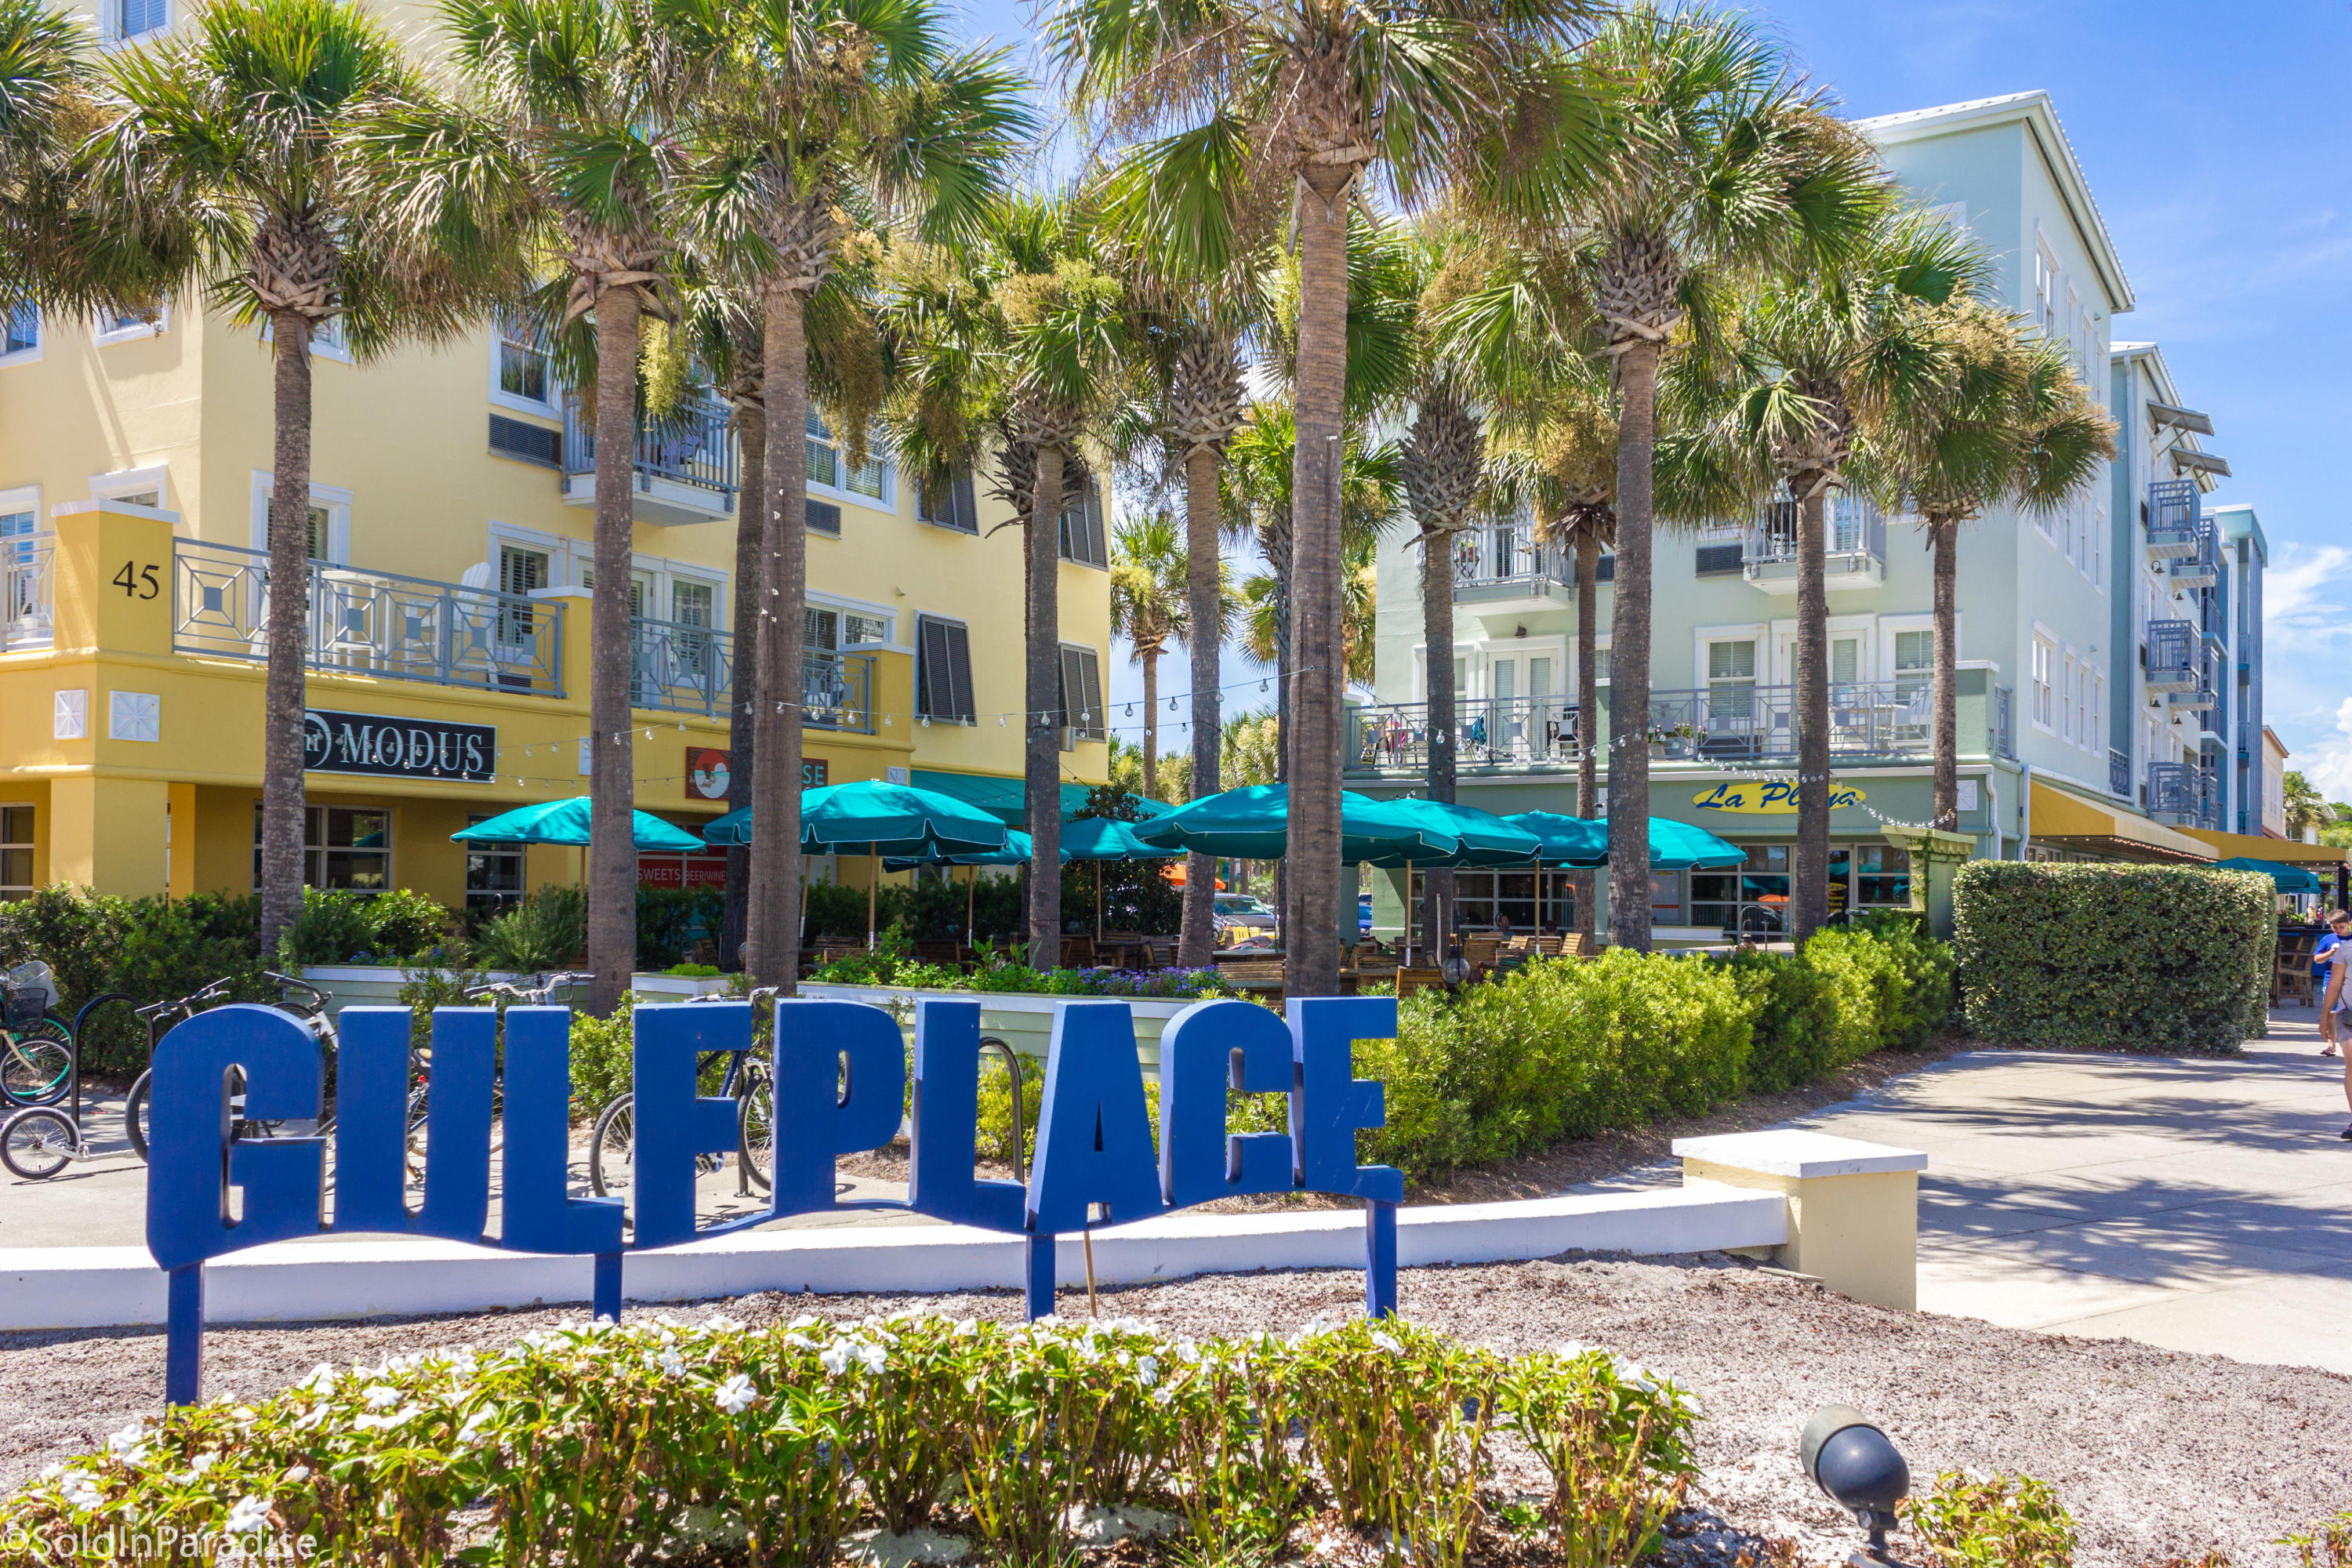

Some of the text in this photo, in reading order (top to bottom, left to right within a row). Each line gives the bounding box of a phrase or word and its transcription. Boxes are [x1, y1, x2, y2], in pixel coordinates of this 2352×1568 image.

[112, 560, 160, 600] 45
[339, 723, 484, 773] MODUS
[1695, 784, 1746, 809] La
[637, 867, 726, 882] SWEETS BEER/WINE
